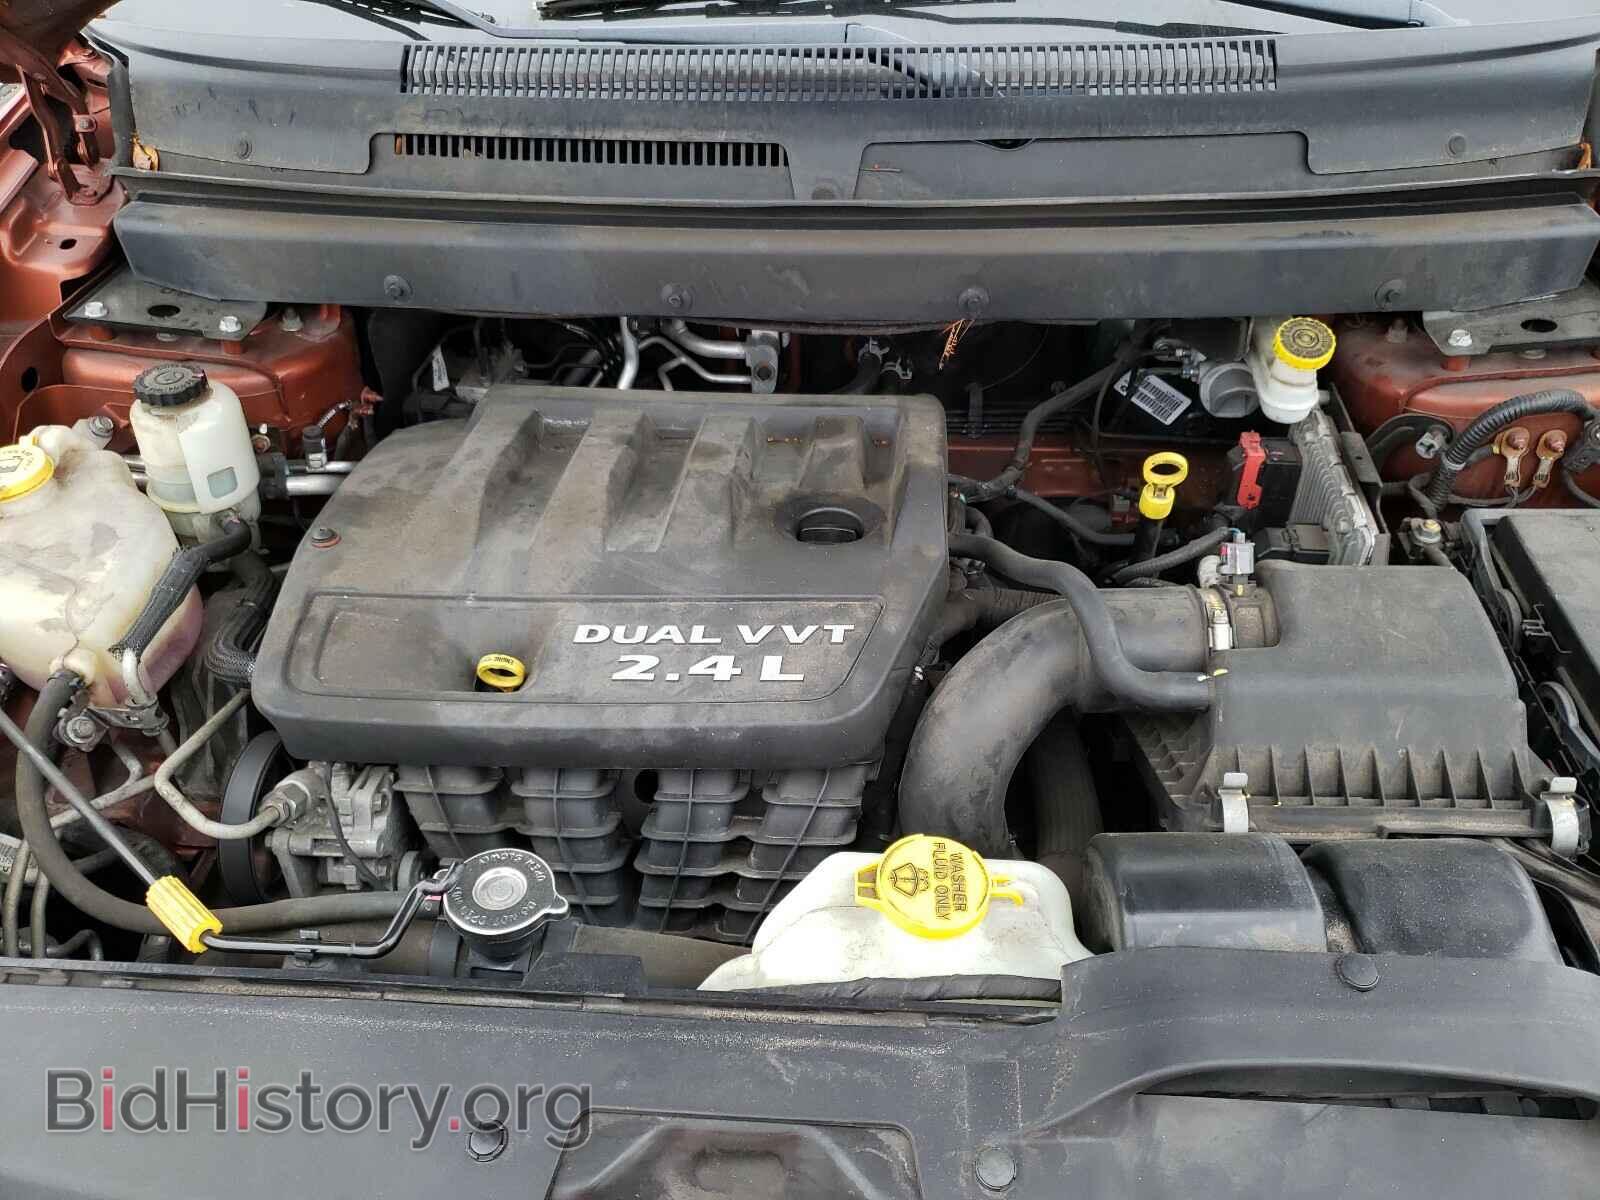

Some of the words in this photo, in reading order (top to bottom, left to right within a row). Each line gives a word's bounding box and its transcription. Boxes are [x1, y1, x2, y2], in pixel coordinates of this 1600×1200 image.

[573, 624, 722, 644] DUAL
[737, 624, 855, 644] VVT
[611, 655, 742, 681] 2.4
[760, 655, 804, 681] L
[932, 842, 949, 880] FLUID
[949, 852, 968, 912] WASHER
[934, 885, 951, 920] ONLY
